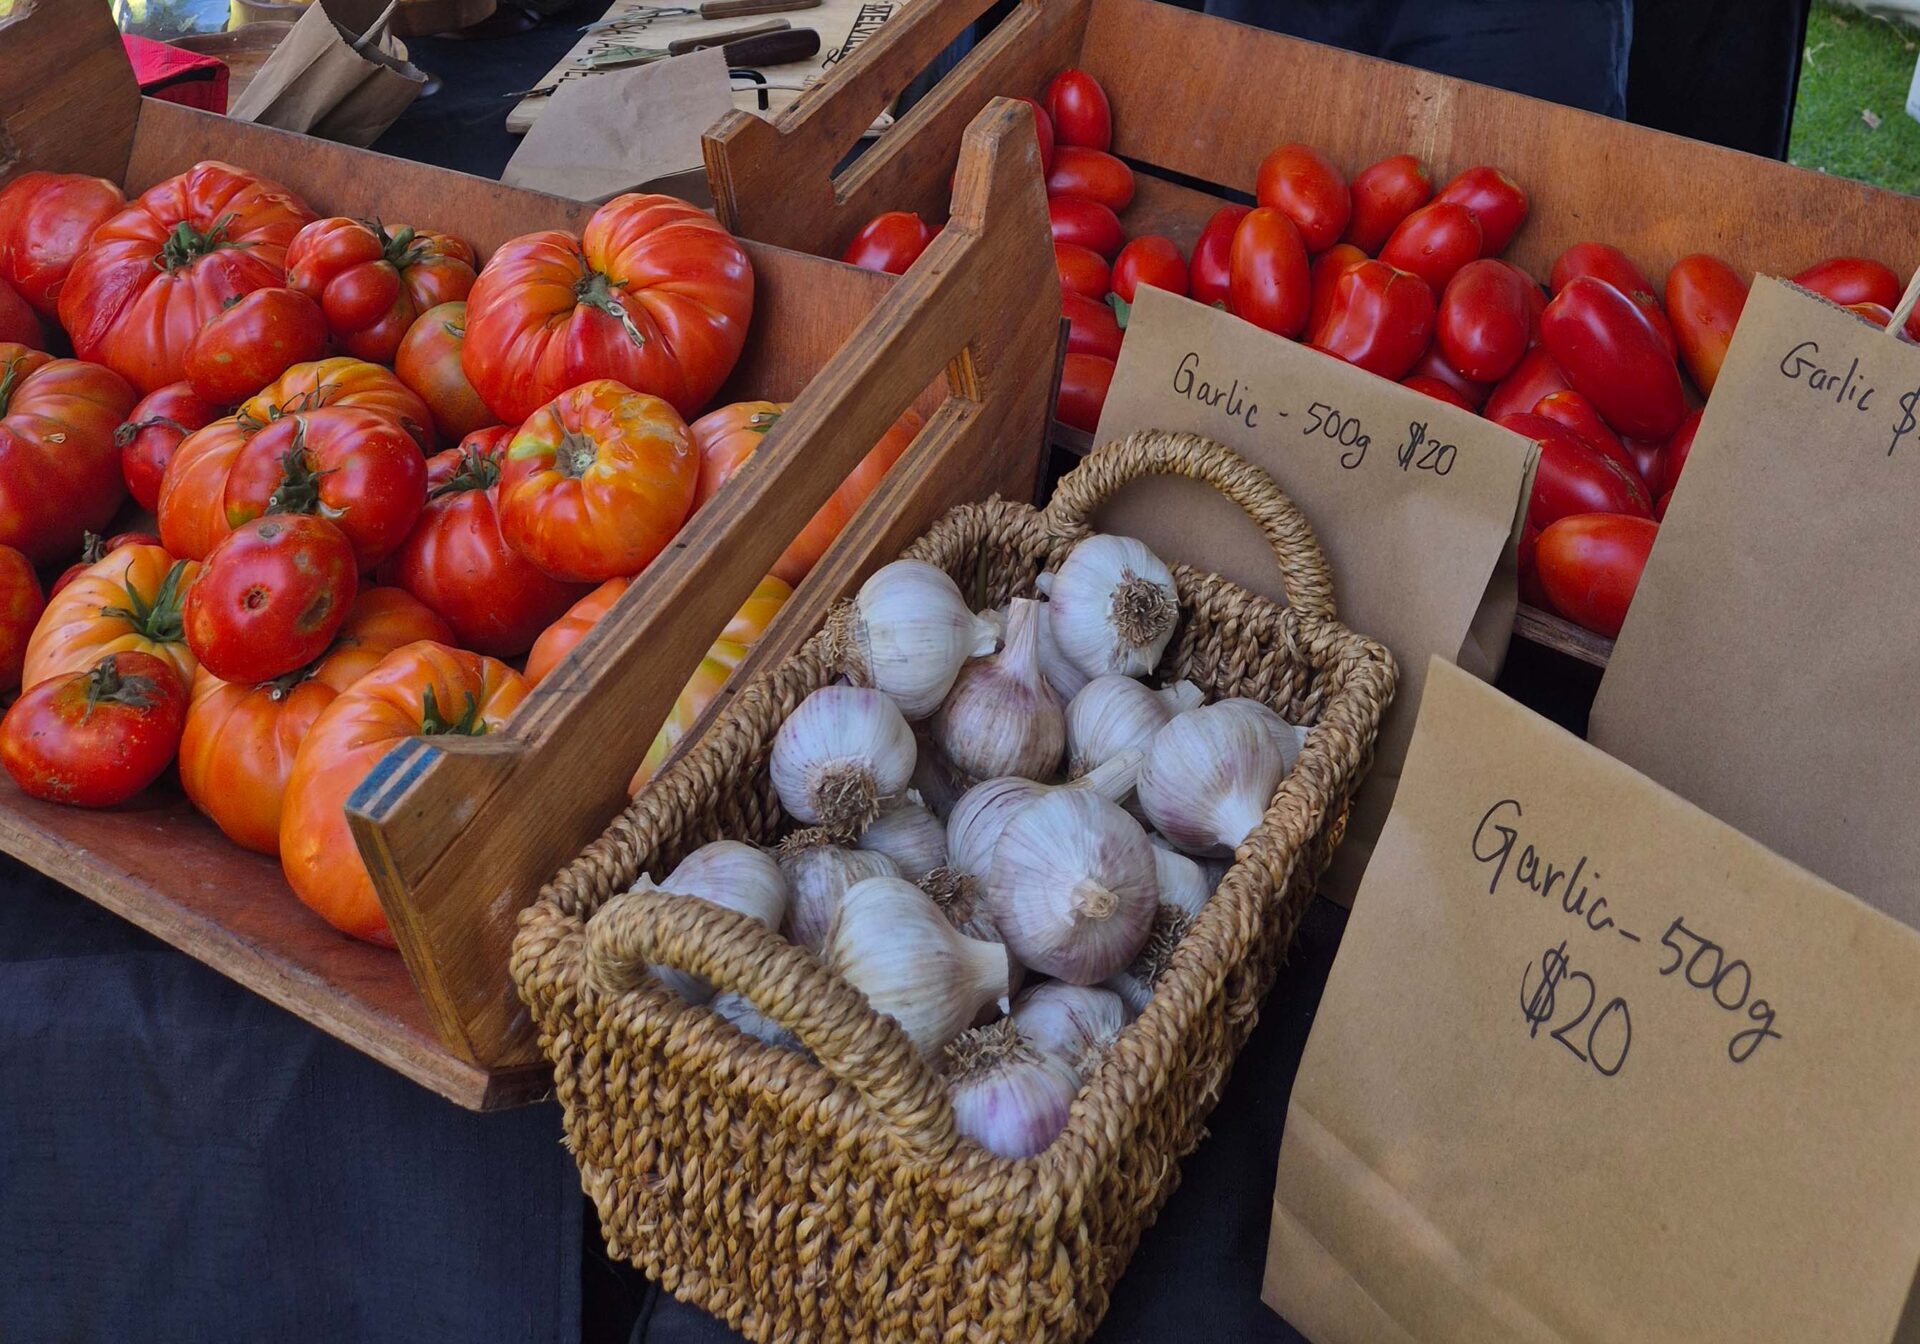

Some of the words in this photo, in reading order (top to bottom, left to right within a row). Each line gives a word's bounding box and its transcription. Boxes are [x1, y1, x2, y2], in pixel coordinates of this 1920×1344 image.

[1173, 351, 1258, 428] Garlic
[1302, 401, 1372, 470] 500g
[1397, 420, 1458, 476] $20
[1779, 341, 1875, 412] Garlic
[1520, 939, 1632, 1077] $20
[1659, 916, 1783, 1064] 500g
